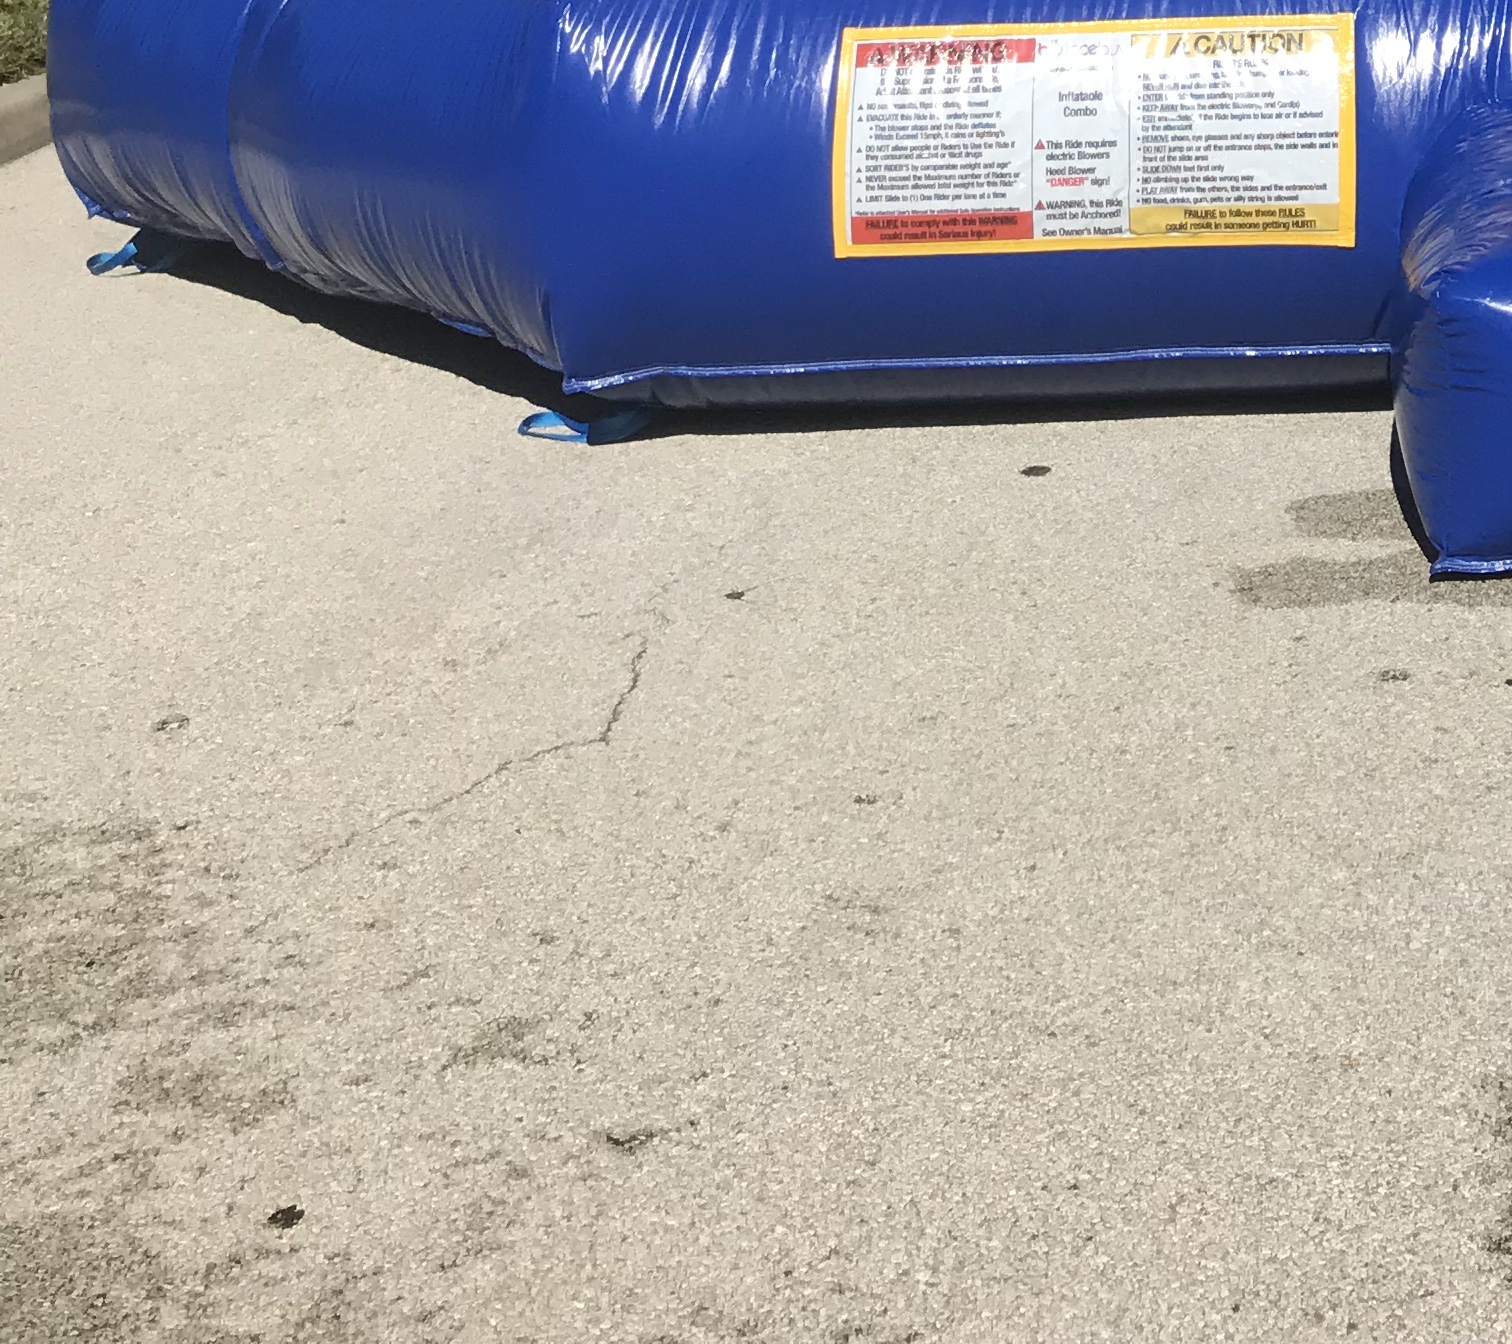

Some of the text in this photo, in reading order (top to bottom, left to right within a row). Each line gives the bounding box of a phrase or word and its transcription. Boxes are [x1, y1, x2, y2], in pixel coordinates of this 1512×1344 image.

[1194, 33, 1303, 55] CAUTION
[1059, 90, 1103, 102] Inflatable
[1064, 105, 1097, 117] Combo
[910, 144, 931, 152] people
[1046, 138, 1117, 149] This Ride requires
[965, 151, 983, 159] drugs
[1046, 151, 1110, 161] electric Blowers
[911, 164, 919, 172] by
[960, 162, 981, 170] weight
[1046, 166, 1096, 176] Heed Blower
[1091, 176, 1110, 187] sign!
[910, 194, 918, 203] (1)
[1090, 199, 1103, 208] this
[1106, 198, 1123, 207] Ride
[1046, 209, 1121, 220] must be Anchored!
[1184, 208, 1305, 218] FAILURE to follow these RULES
[866, 220, 899, 229] FAILURE
[910, 219, 940, 228] comply
[942, 218, 960, 226] with
[962, 217, 976, 225] this
[1165, 221, 1187, 230] could
[1190, 221, 1212, 230] result
[1214, 221, 1222, 229] in
[1224, 221, 1260, 230] someone
[1262, 220, 1289, 230] getting
[880, 232, 902, 240] could
[904, 231, 927, 239] result
[939, 230, 968, 238] Serious
[1042, 225, 1123, 237] See Owner's Manual
